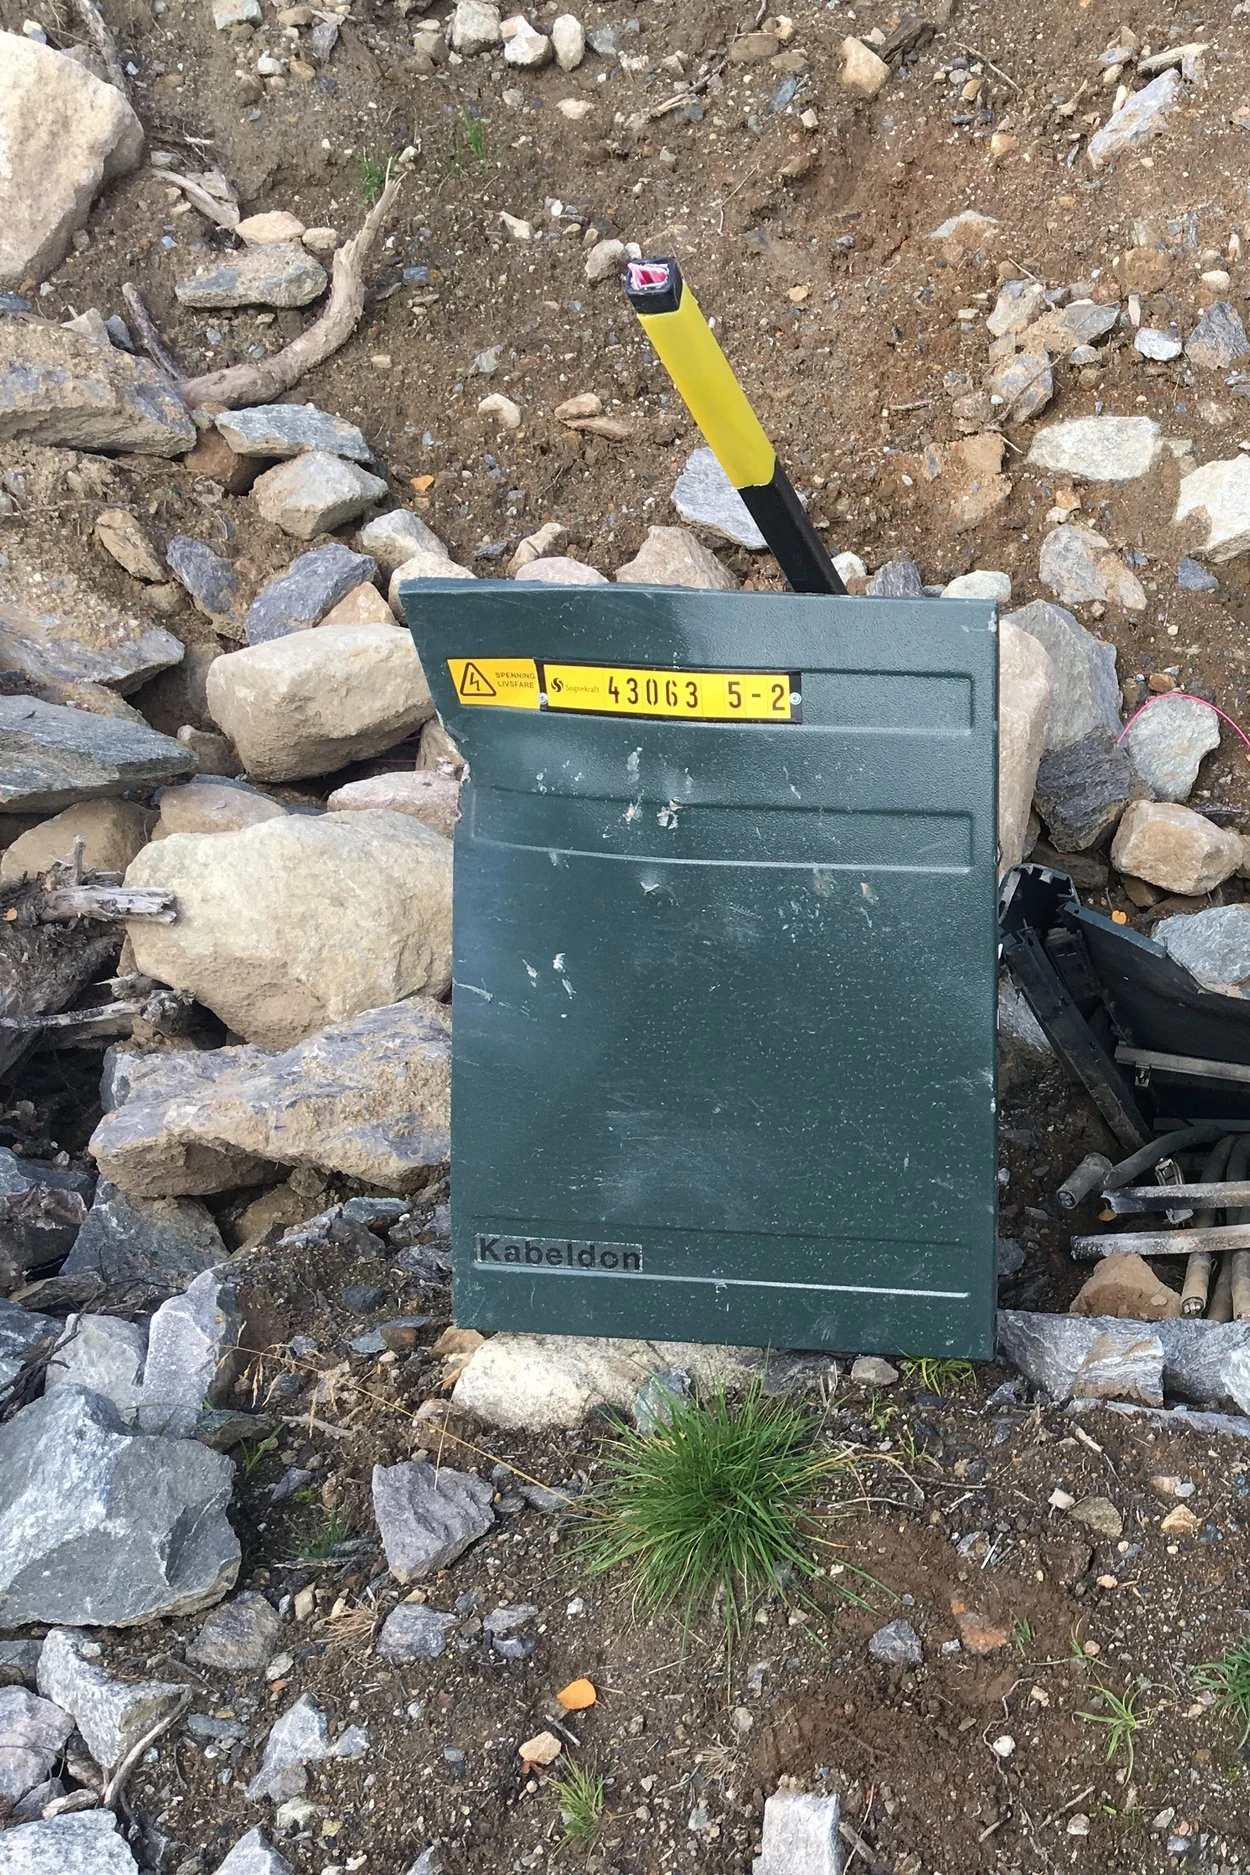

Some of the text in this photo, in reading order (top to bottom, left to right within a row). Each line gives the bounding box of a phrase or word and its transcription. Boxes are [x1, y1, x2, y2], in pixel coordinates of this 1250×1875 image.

[495, 671, 536, 680] SPENNING
[497, 680, 535, 689] LIVSFARE
[565, 684, 600, 694] Sognekraft
[608, 676, 786, 712] 43063 5-2
[479, 1238, 641, 1270] Kabeldon
